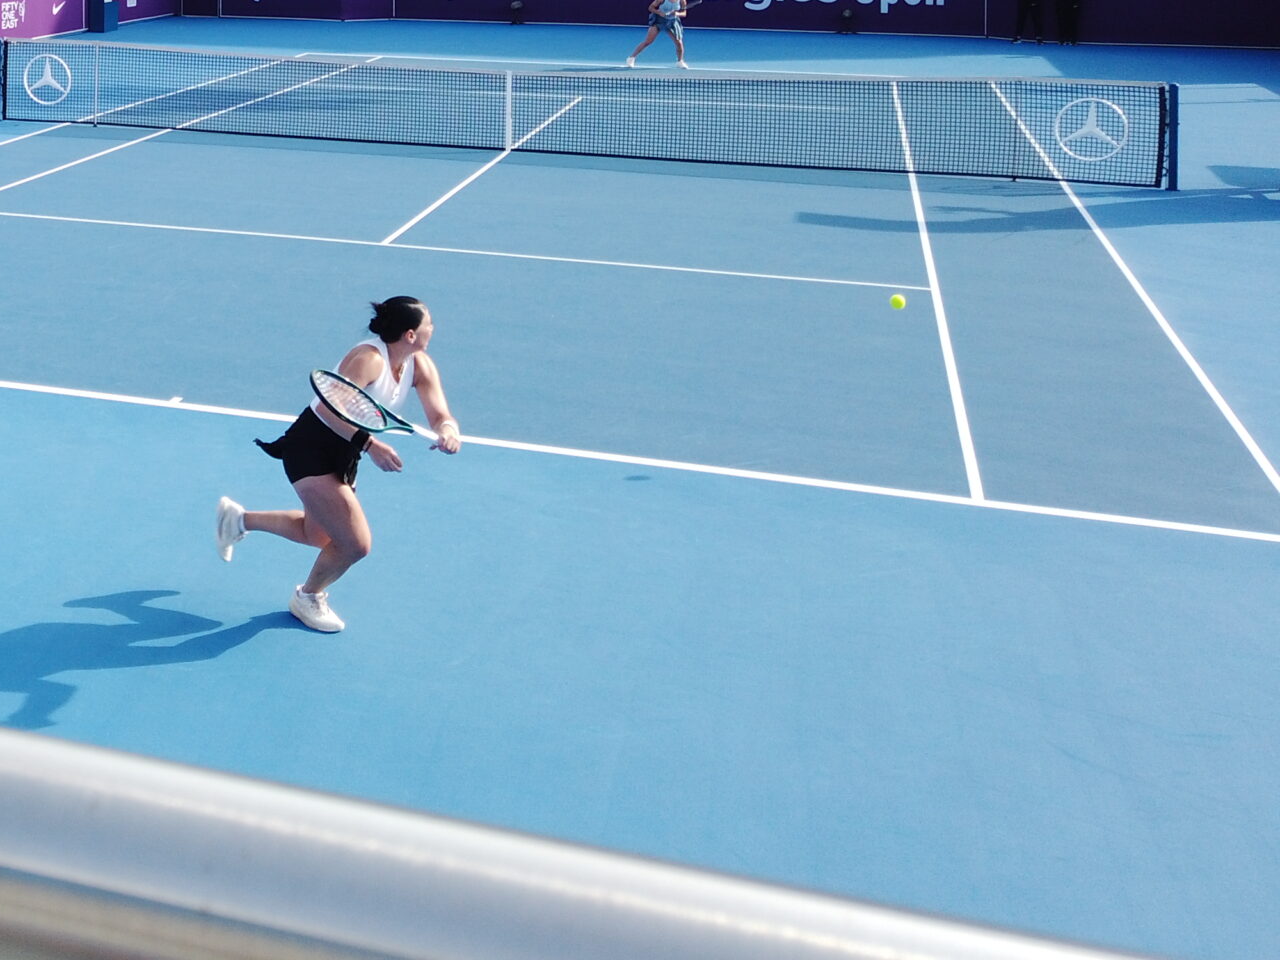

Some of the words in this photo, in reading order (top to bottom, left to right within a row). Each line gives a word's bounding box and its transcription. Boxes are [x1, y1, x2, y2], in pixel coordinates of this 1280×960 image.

[1, 1, 18, 12] FIFTY
[1, 10, 15, 20] ONE
[1, 19, 18, 30] EAST
